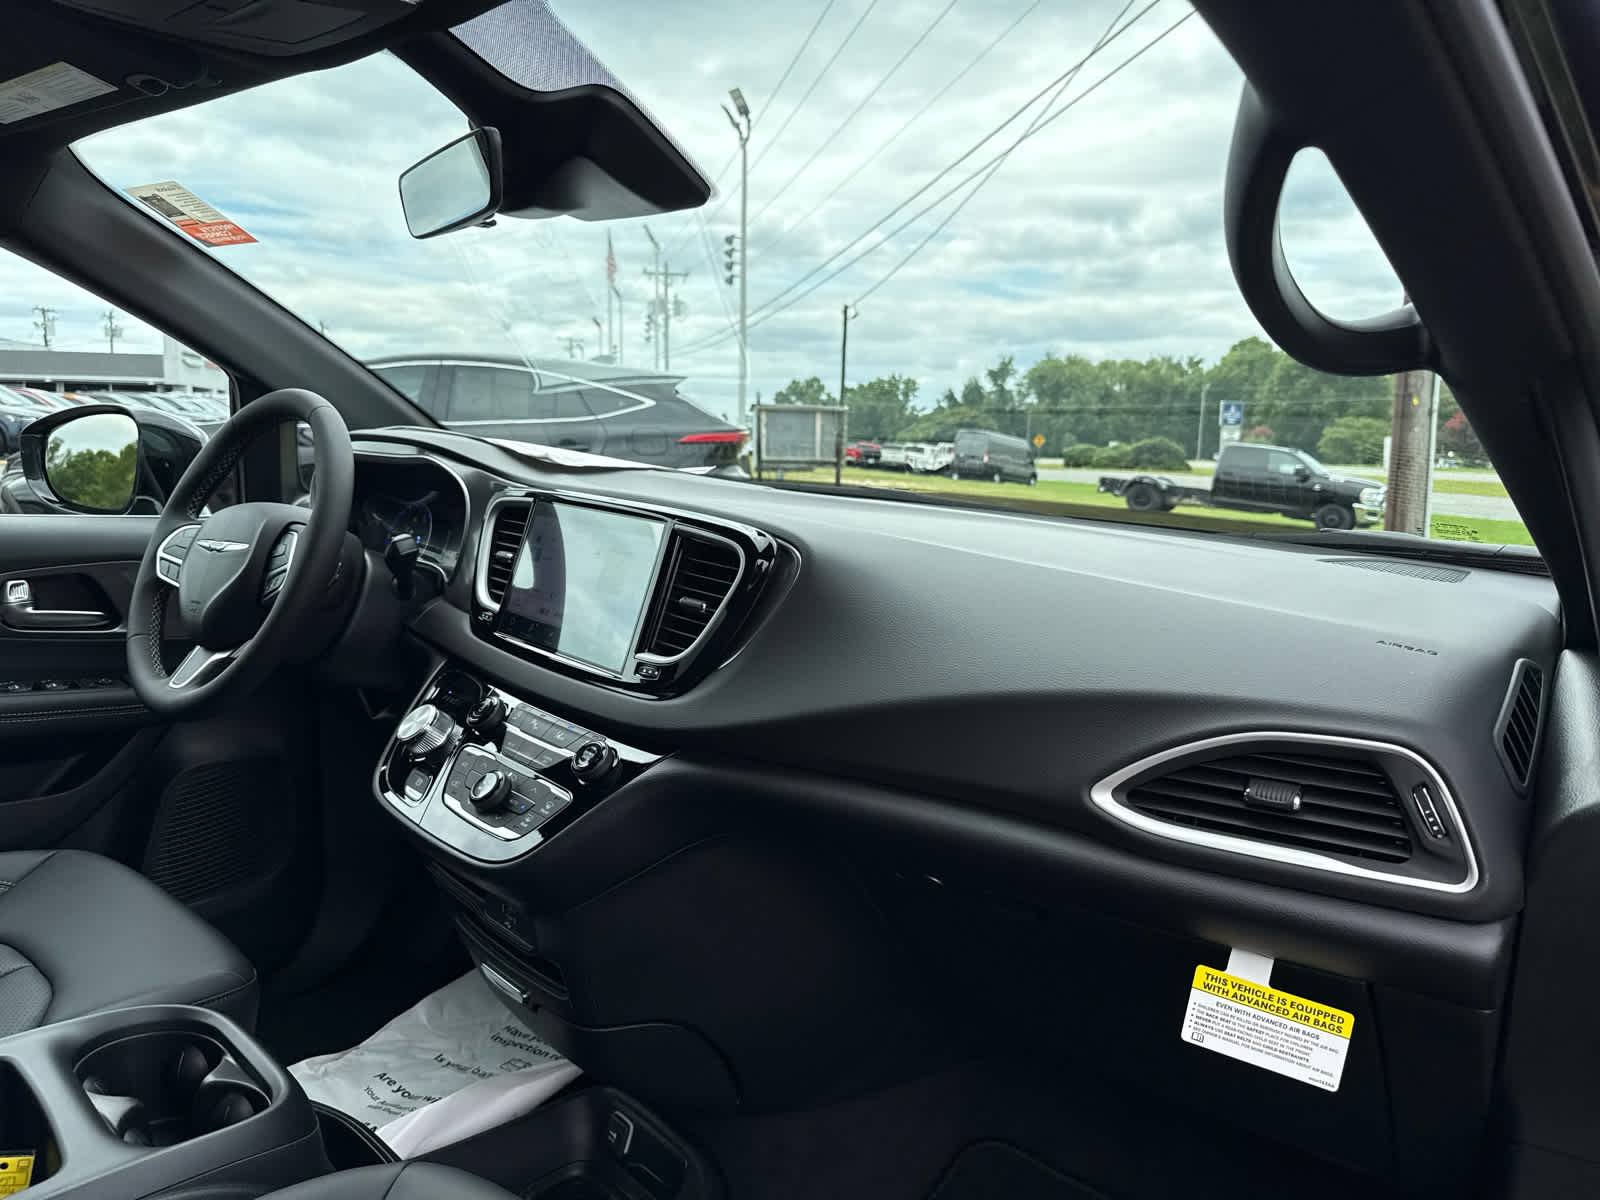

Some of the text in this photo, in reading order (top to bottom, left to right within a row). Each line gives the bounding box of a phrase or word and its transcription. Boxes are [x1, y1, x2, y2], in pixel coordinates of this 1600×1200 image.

[1375, 640, 1438, 656] AIRBAG
[1202, 981, 1342, 1034] WITH ADVANCED AIR BAGS
[1204, 972, 1344, 1025] THIS VEHICLE IS EQUIPPED
[1215, 1001, 1320, 1040] EVEN WITH ADVANCED AIR BAGS
[373, 1072, 397, 1087] Are
